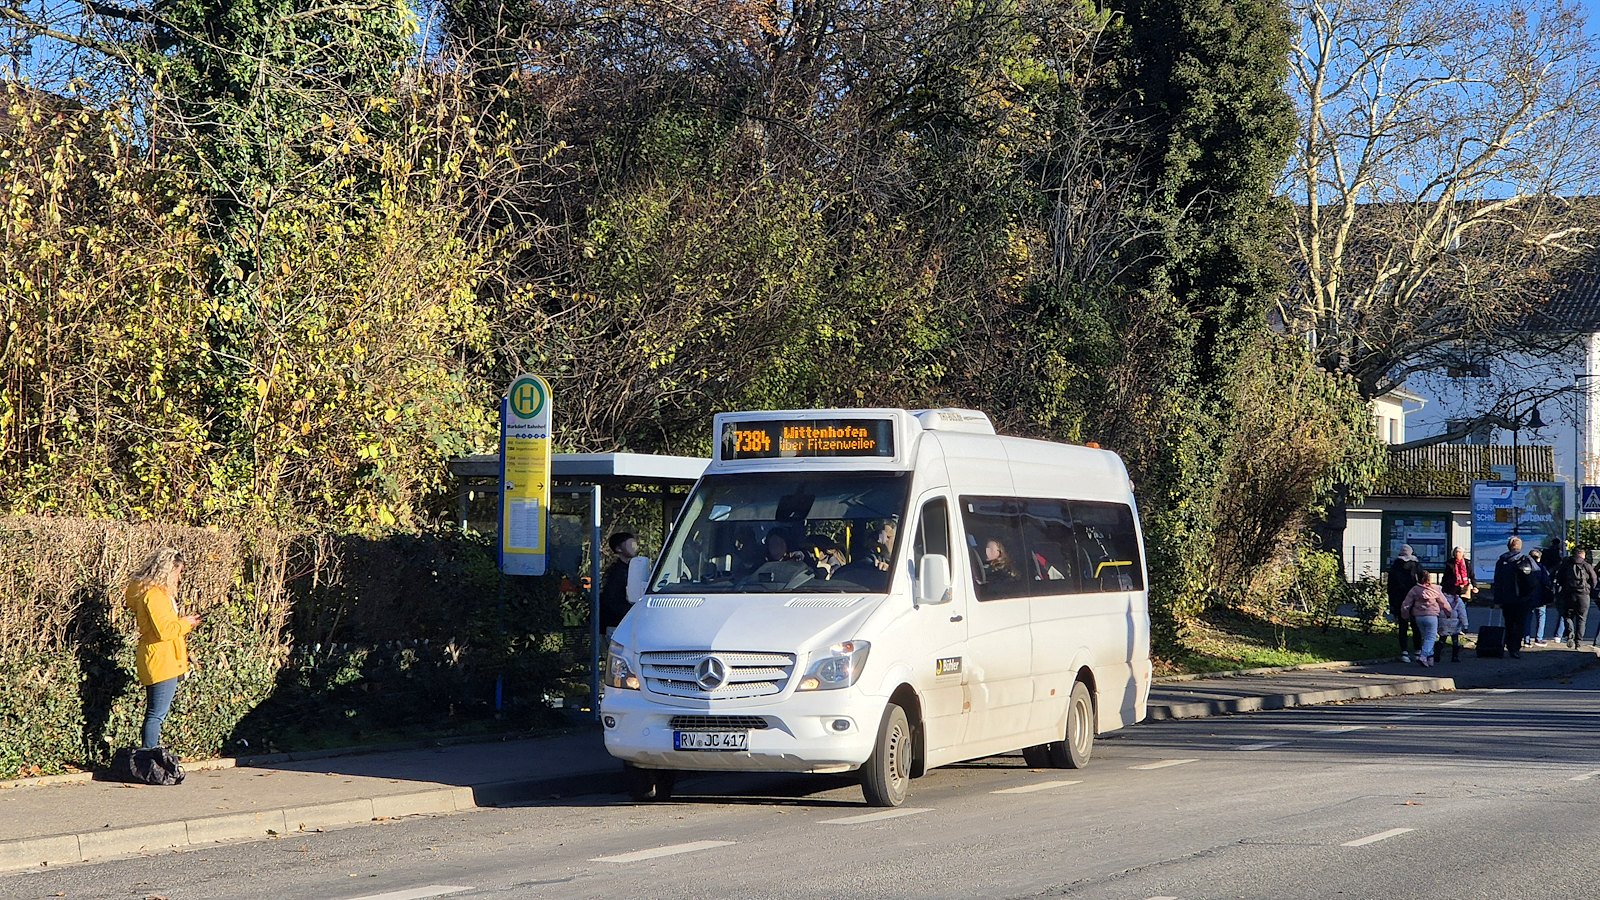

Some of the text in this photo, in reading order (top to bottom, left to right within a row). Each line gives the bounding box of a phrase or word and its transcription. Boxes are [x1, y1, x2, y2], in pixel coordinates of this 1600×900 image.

[519, 386, 534, 410] H
[783, 425, 869, 439] Wittenhofen
[734, 430, 771, 452] 7384
[779, 436, 876, 451] über Fitzenweiler
[681, 733, 746, 747] RV JC 417
